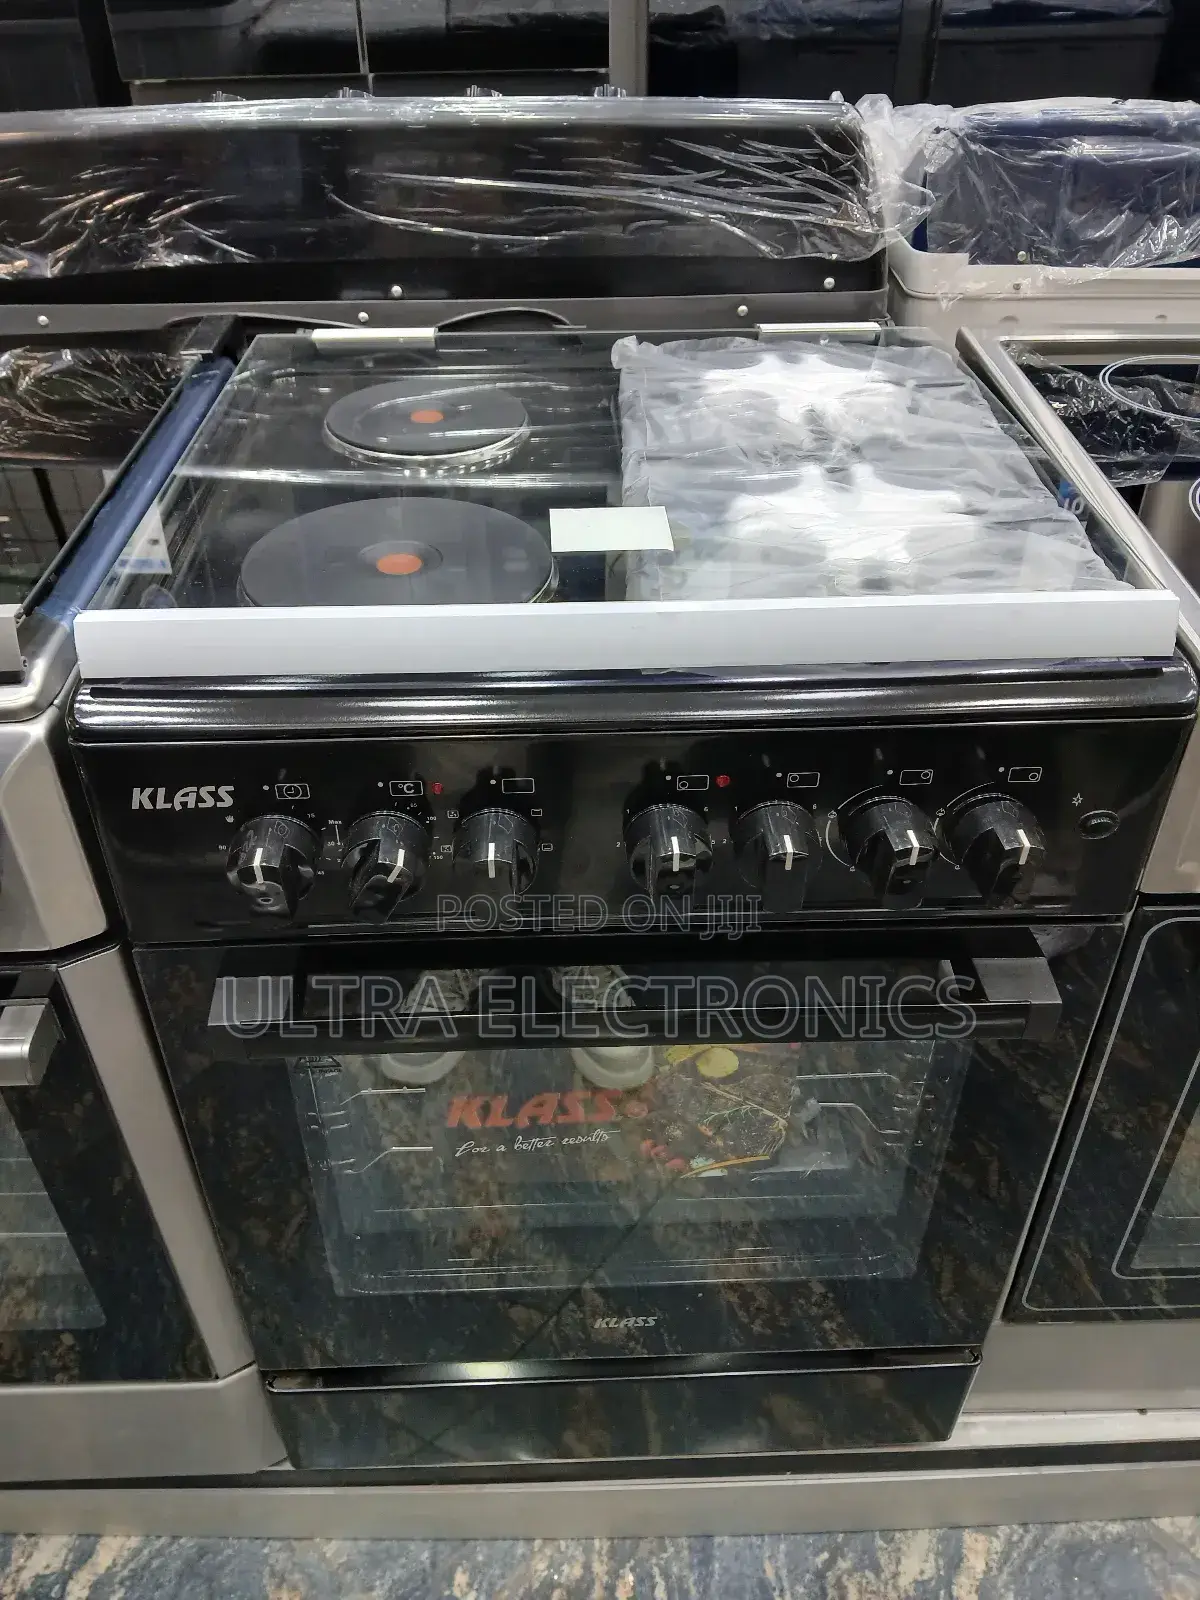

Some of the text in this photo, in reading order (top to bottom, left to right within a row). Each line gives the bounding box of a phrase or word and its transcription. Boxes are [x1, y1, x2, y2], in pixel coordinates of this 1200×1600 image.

[131, 785, 235, 811] KLASS
[446, 1088, 623, 1129] KLASS
[495, 1144, 507, 1152] a
[514, 1135, 557, 1152] better
[561, 1128, 621, 1145] results
[594, 1316, 658, 1328] KLASS
